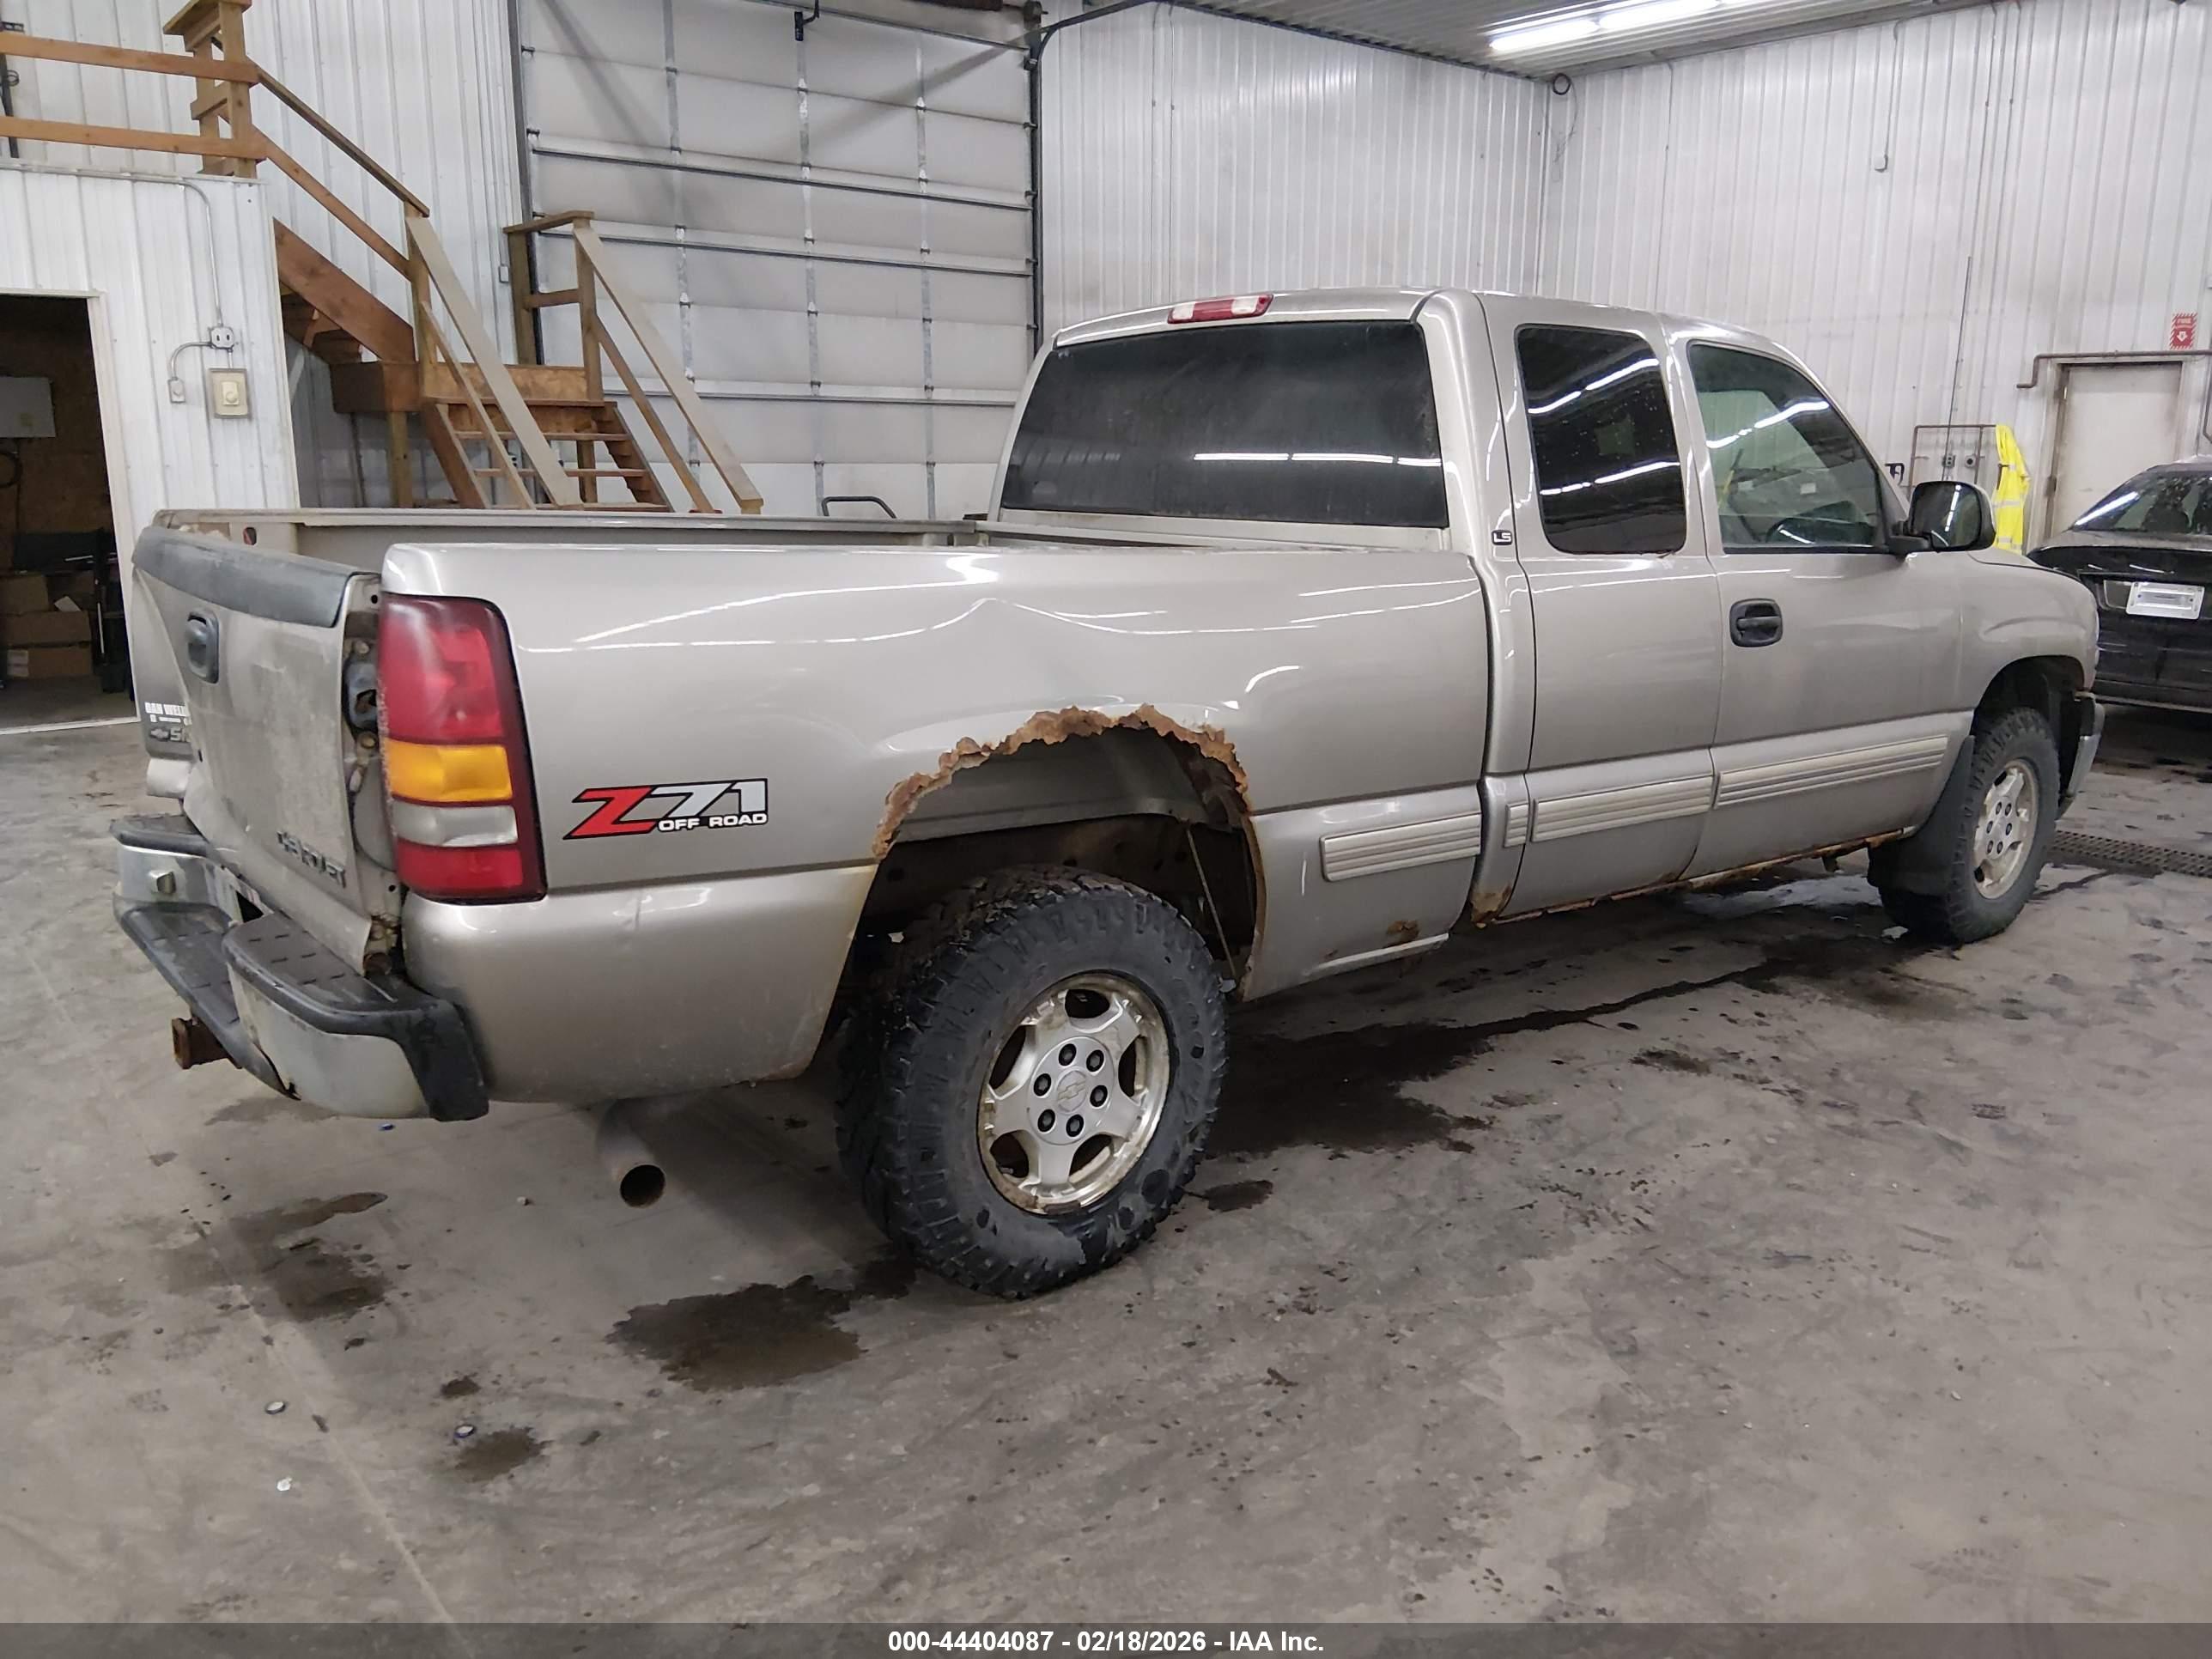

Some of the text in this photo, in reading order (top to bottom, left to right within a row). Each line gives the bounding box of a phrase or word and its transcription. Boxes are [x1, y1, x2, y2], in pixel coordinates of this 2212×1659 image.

[1493, 532, 1512, 543] LS
[562, 778, 768, 840] Z71
[658, 812, 768, 831] OFF ROAD
